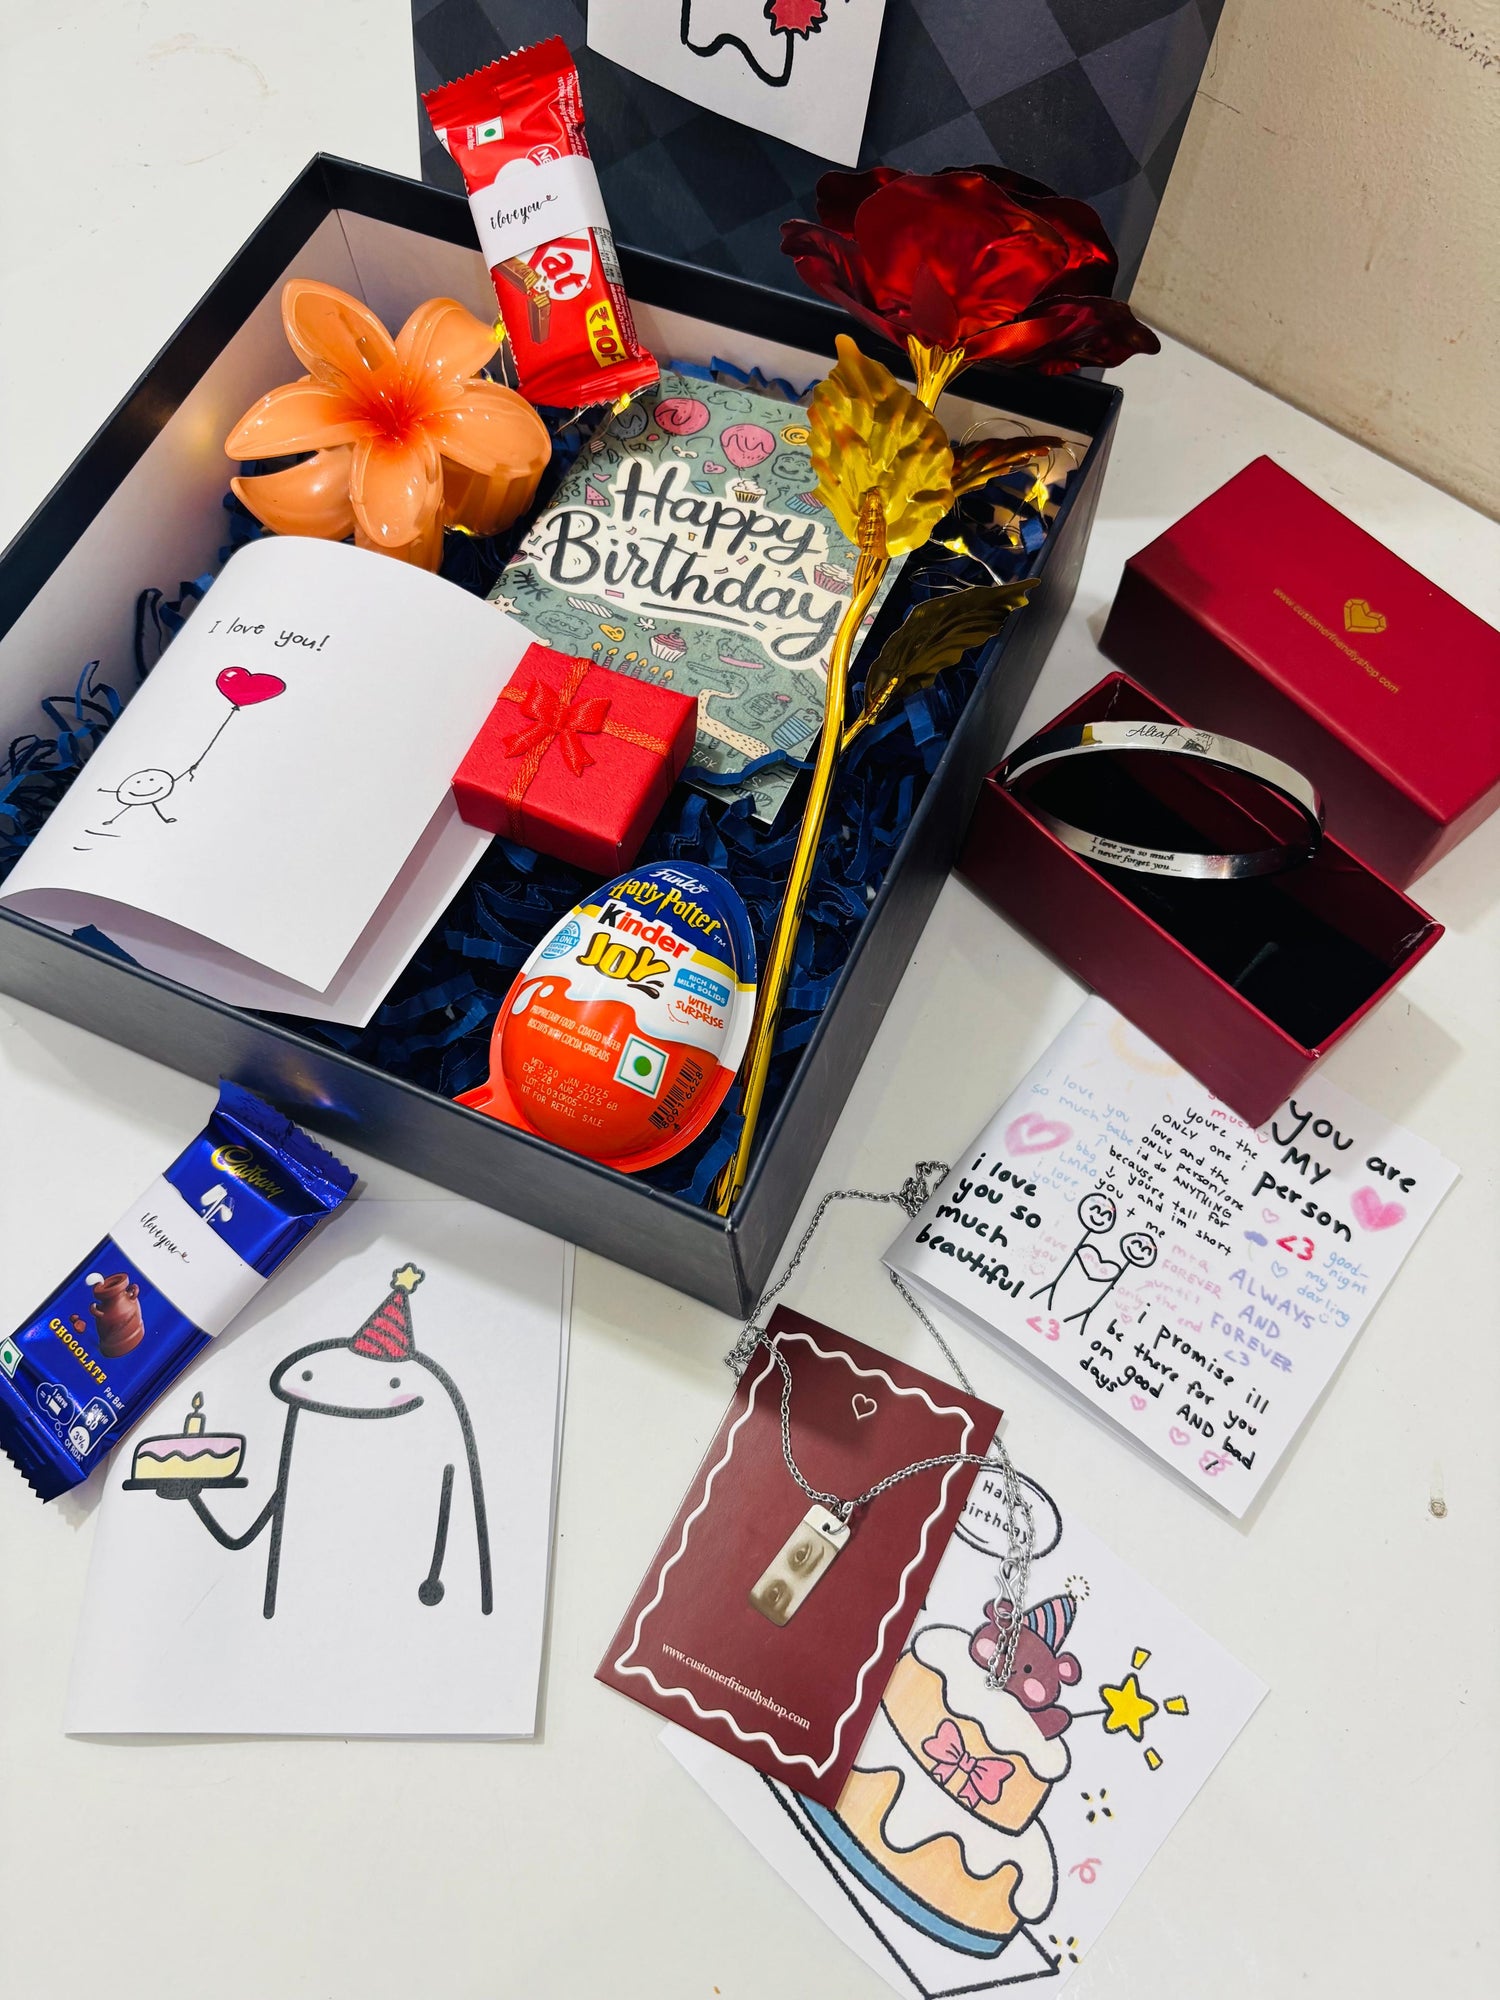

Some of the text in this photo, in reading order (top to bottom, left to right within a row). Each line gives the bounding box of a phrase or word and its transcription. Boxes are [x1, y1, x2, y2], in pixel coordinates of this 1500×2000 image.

[497, 209, 519, 229] love
[520, 200, 542, 224] you
[614, 461, 821, 564] Happy
[542, 510, 844, 659] Birthday
[208, 617, 330, 651] I love you!
[1273, 588, 1399, 694] www.customerfriendlyshop.com
[1126, 724, 1178, 744] Altaf
[1098, 849, 1121, 860] never
[1121, 855, 1150, 868] forget
[1099, 838, 1117, 850] love
[1119, 845, 1135, 856] you
[1150, 854, 1175, 862] much
[649, 868, 709, 894] Funko
[608, 878, 665, 905] Harry
[656, 887, 721, 936] Potter
[677, 978, 725, 1004] MILK SOLIDS
[689, 975, 718, 992] RICH IN
[676, 1000, 723, 1028] SURPRISE
[689, 995, 712, 1014] WITH
[548, 1027, 563, 1041] WITH
[561, 1034, 582, 1051] COCOA
[582, 1042, 611, 1062] SPREADS
[559, 1016, 576, 1029] FOOD
[577, 1024, 602, 1042] COATED
[601, 1035, 621, 1051] WAFER
[558, 1083, 574, 1094] AUG
[577, 1091, 602, 1105] 2025
[564, 1077, 580, 1088] JAN
[583, 1084, 609, 1099] 2025
[1063, 1075, 1095, 1100] love
[1102, 1103, 1130, 1122] you
[533, 1091, 546, 1104] FOR
[551, 1101, 576, 1118] RETAIL
[583, 1114, 604, 1127] SALE
[1031, 1083, 1134, 1146] so much babe
[1141, 1136, 1173, 1160] ONLY
[1151, 1123, 1229, 1185] love and the
[1162, 1114, 1248, 1171] ONLY one i
[1235, 1139, 1258, 1160] the
[211, 1144, 285, 1199] Cadbury
[971, 1152, 1037, 1197] i love
[1029, 1171, 1061, 1189] you
[1051, 1167, 1079, 1187] love
[1059, 1151, 1097, 1177] LMAO
[1109, 1145, 1198, 1220] because youre tall
[1366, 1156, 1417, 1193] are
[952, 1178, 1042, 1228] you so
[1136, 1147, 1232, 1228] id do ANYTHING for
[935, 1204, 1008, 1248] much
[1094, 1178, 1124, 1199] you
[1145, 1221, 1166, 1238] me
[1137, 1193, 1232, 1256] and im short
[915, 1223, 1025, 1298] beautiful
[1161, 1259, 1223, 1300] FOREVER
[1305, 1270, 1328, 1292] my
[1329, 1269, 1368, 1295] night
[1228, 1268, 1316, 1330] ALWAYS
[1297, 1284, 1350, 1328] darling
[1177, 1318, 1203, 1334] end
[1238, 1305, 1280, 1339] AND
[49, 1318, 107, 1385] CHOCOLATE
[1138, 1302, 1270, 1415] i promise ill
[1210, 1311, 1293, 1373] FOREVER
[1079, 1356, 1118, 1393] days
[1106, 1318, 1258, 1436] be there for you
[55, 1392, 69, 1409] serve
[103, 1386, 125, 1410] Per Bar
[1090, 1340, 1256, 1471] on good AND bad
[73, 1430, 85, 1450] 3%
[662, 1643, 811, 1730] www.customerfriendlyshop.com
